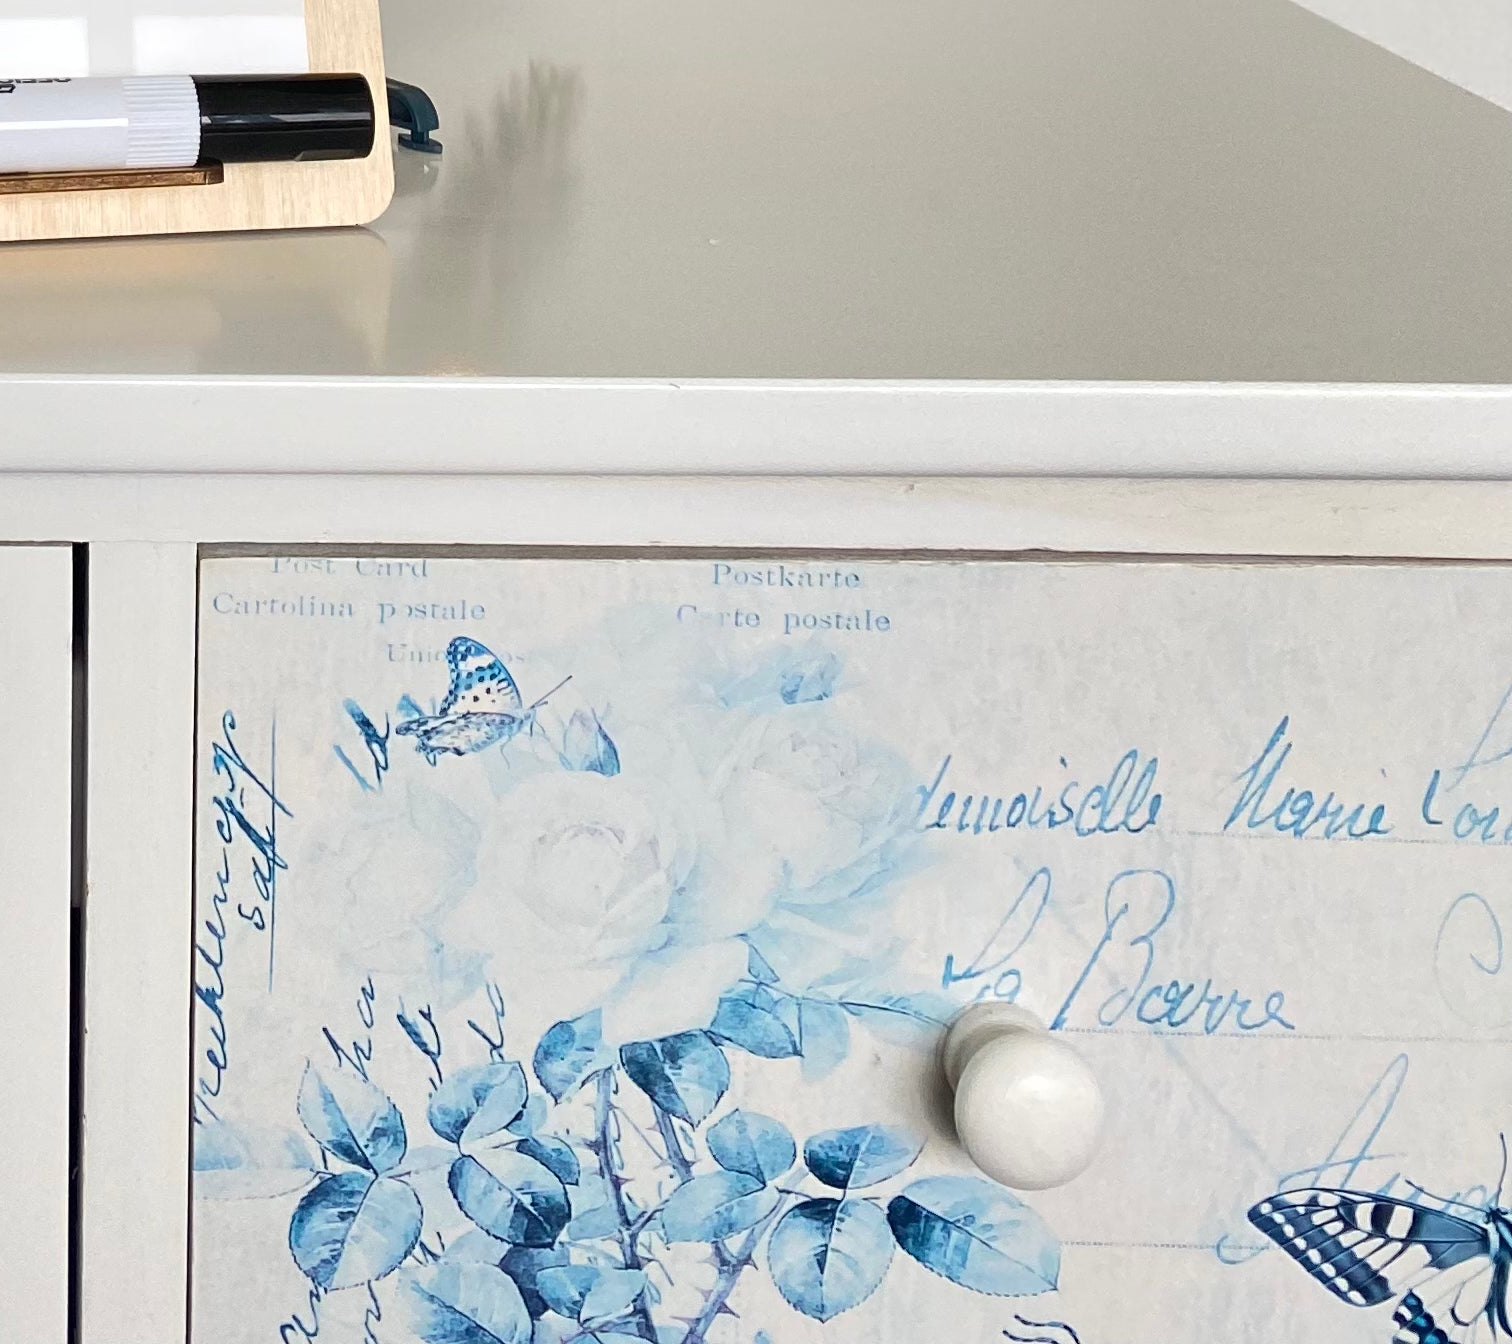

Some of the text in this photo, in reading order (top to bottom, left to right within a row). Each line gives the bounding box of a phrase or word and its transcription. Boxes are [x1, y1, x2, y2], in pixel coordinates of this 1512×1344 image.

[712, 563, 862, 589] Postkarte
[212, 591, 354, 618] Cartolina
[675, 604, 891, 635] Crte postale
